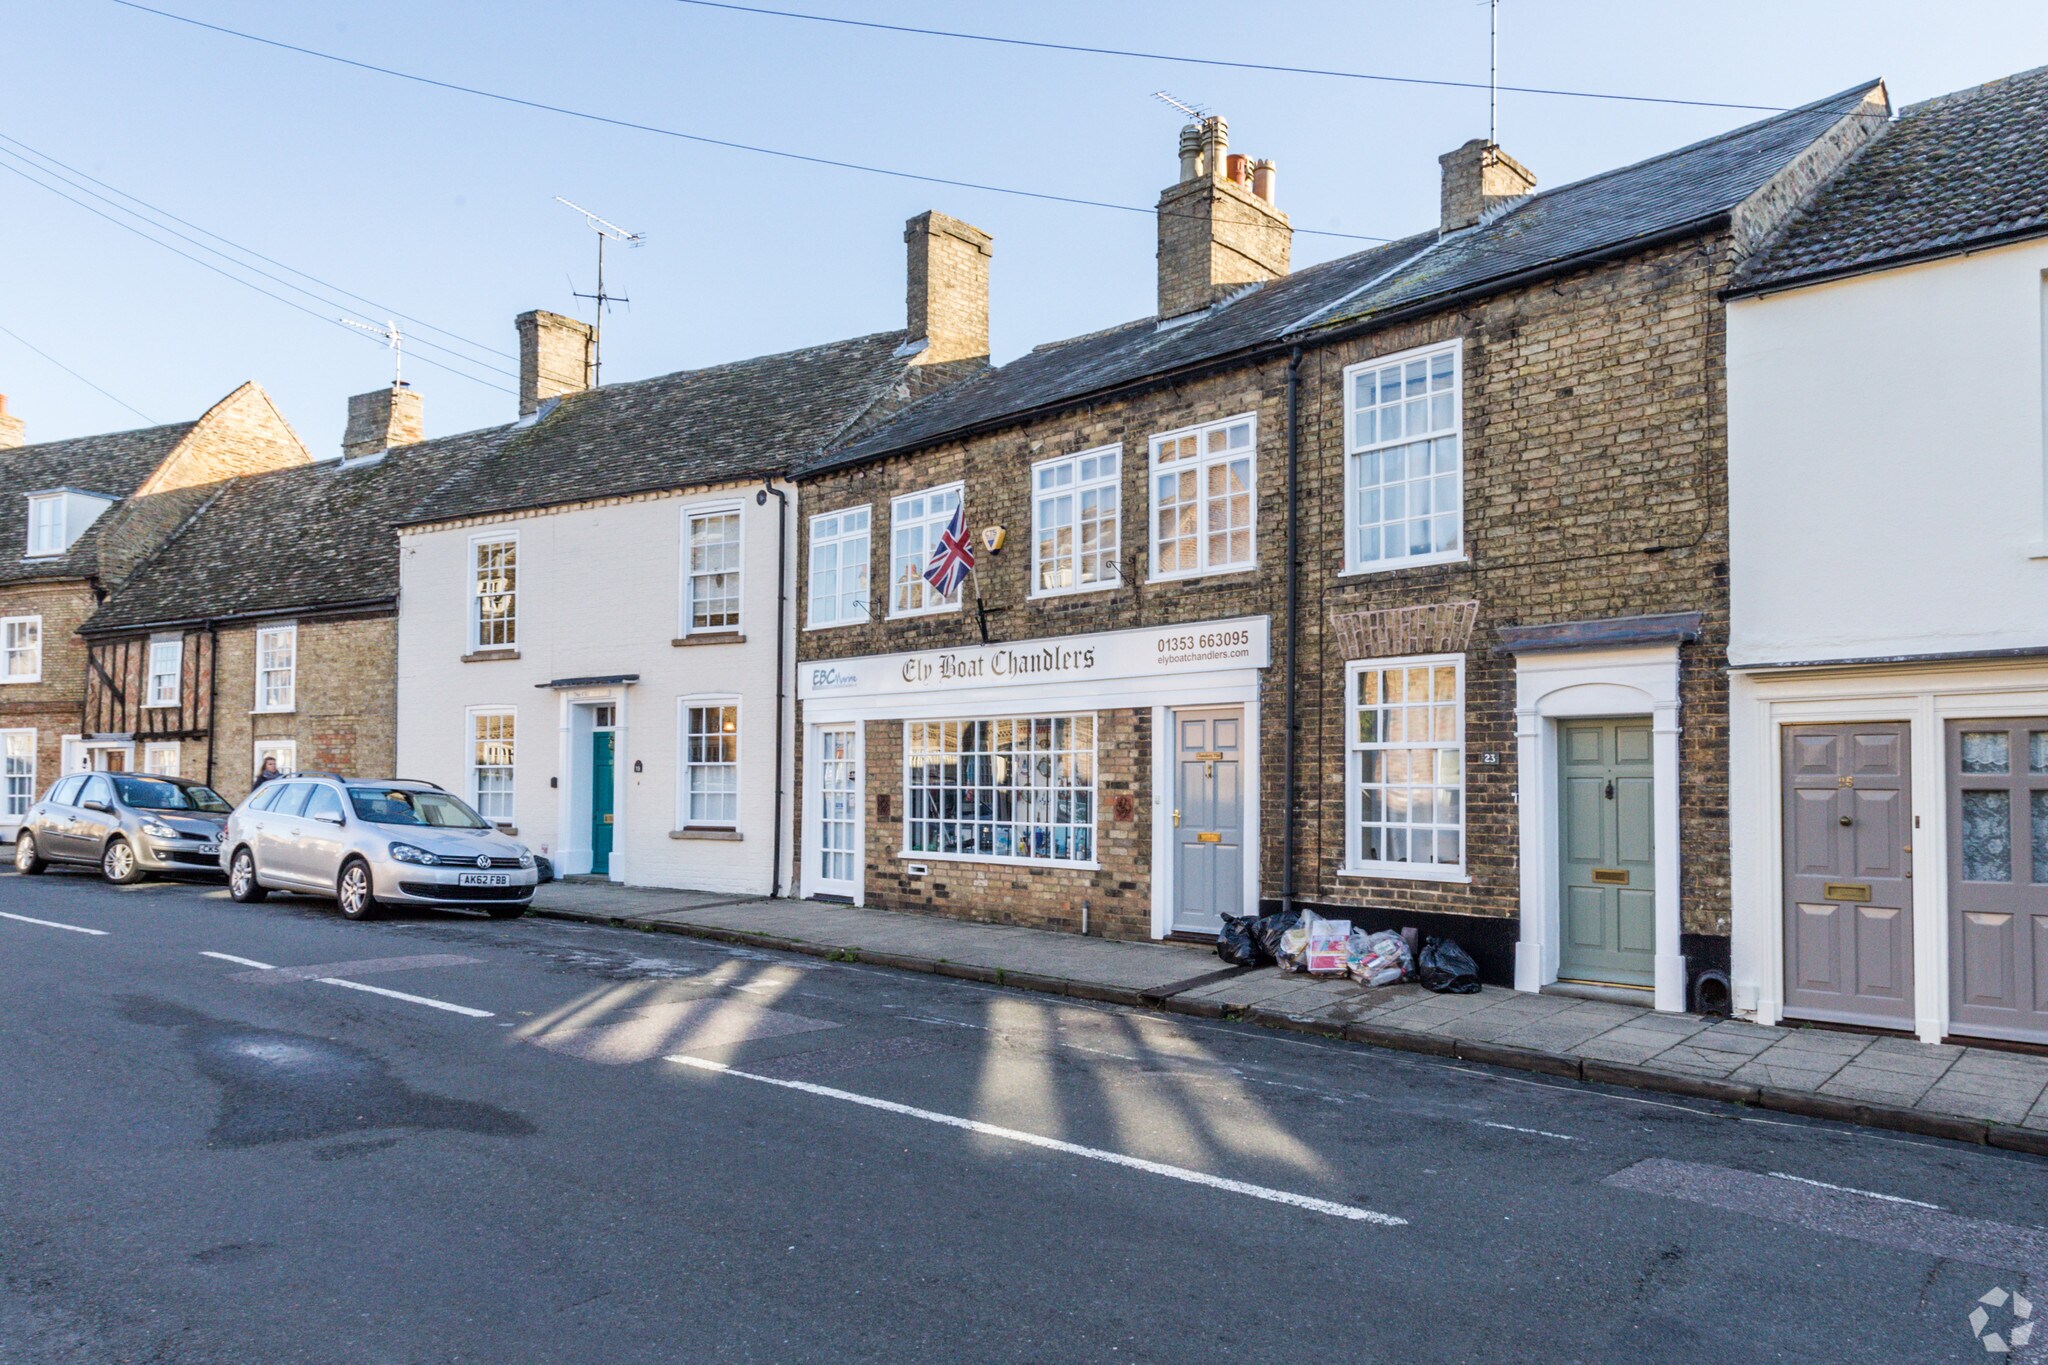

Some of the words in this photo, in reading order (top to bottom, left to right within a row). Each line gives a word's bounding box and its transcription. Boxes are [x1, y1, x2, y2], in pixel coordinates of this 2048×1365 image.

[1157, 636, 1195, 653] 01353
[1199, 630, 1249, 649] 663095
[902, 658, 932, 686] Ely
[939, 654, 984, 683] Boat
[991, 645, 1095, 680] Chandlers
[1157, 648, 1249, 666] elyboatchandlers.com
[813, 668, 835, 686] EBC
[1484, 753, 1496, 763] 23
[464, 875, 488, 884] AK62
